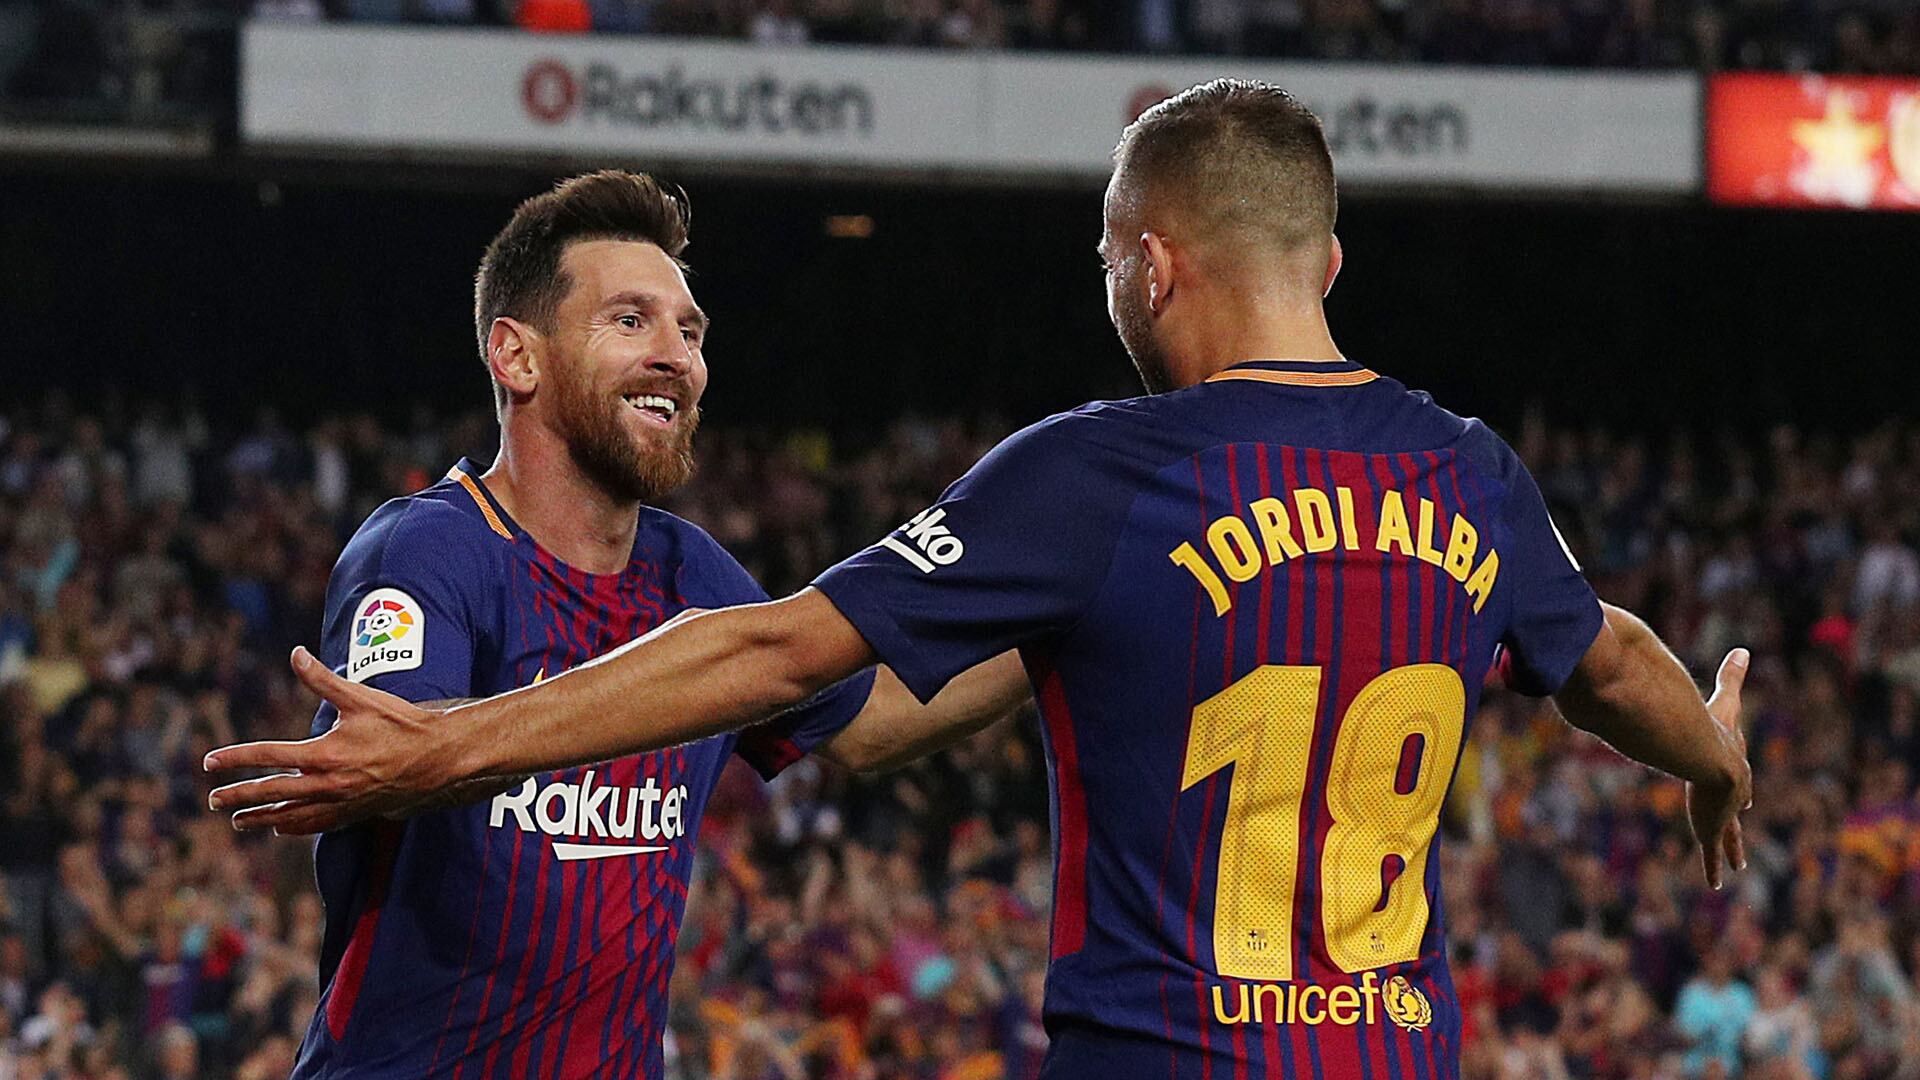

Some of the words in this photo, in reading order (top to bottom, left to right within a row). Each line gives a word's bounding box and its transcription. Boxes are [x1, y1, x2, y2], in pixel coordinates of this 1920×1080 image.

[1310, 92, 1470, 155] uten
[1169, 487, 1360, 617] JORDI
[1375, 489, 1500, 615] ALBA
[353, 647, 413, 673] LaLiga
[1181, 663, 1466, 981] 18
[1211, 971, 1380, 1025] unicef
